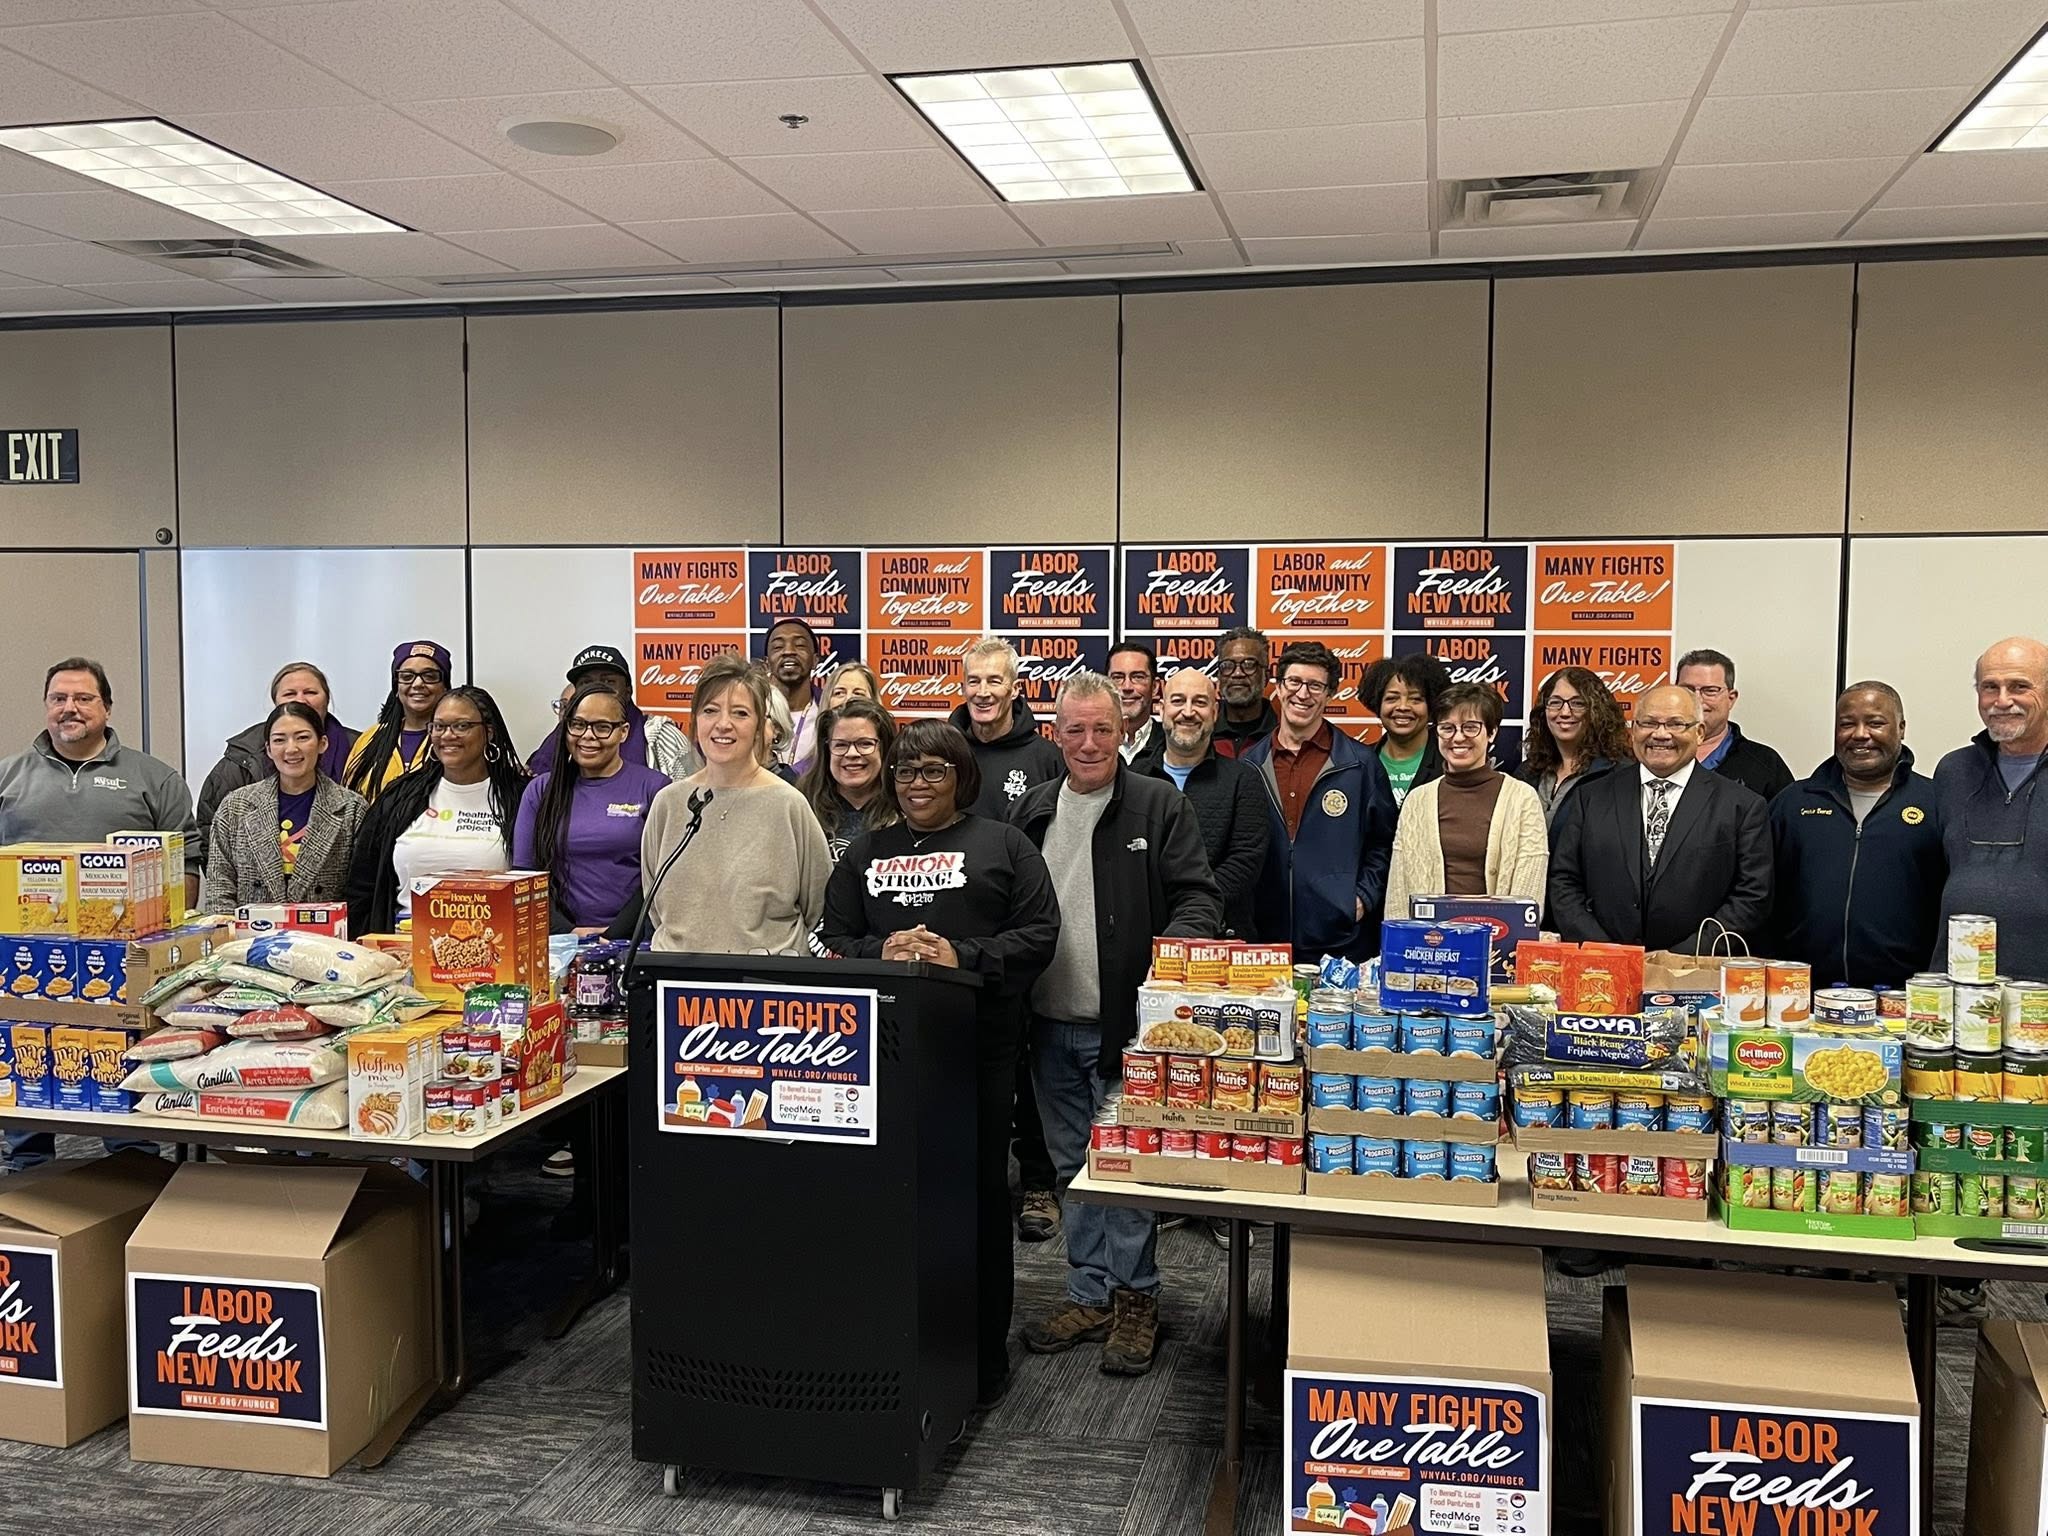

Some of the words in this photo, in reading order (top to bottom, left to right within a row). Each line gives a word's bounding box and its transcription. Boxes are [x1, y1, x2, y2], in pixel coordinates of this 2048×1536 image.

[8, 432, 62, 480] EXIT
[776, 554, 832, 573] LABOR
[882, 557, 929, 575] LABOR
[933, 556, 971, 574] and
[1021, 552, 1078, 573] LABOR
[1157, 551, 1217, 571] LABOR
[1273, 553, 1325, 571] LABOR
[1329, 551, 1372, 570] and
[1428, 550, 1493, 571] LABOR
[1544, 557, 1595, 576] MANY
[1601, 556, 1665, 576] FIGHTS
[641, 562, 682, 579] MANY
[687, 561, 738, 579] FIGHTS
[766, 569, 847, 598] Feeds
[880, 577, 970, 595] COMMUNITY
[1010, 568, 1094, 598] Feeds
[1146, 567, 1233, 597] Feeds
[1271, 573, 1372, 592] COMMUNITY
[1415, 565, 1510, 597] Feeds
[639, 583, 679, 606] One
[678, 582, 744, 605] Table!
[1540, 580, 1591, 605] One
[1590, 579, 1672, 604] Table!
[759, 593, 798, 614] NEW
[803, 594, 849, 615] YORK
[880, 591, 974, 627] Together
[1003, 593, 1045, 614] NEW
[1049, 593, 1097, 615] YORK
[1138, 592, 1180, 614] NEW
[1186, 592, 1236, 614] YORK
[1270, 588, 1375, 626] Together
[1407, 592, 1453, 614] NEW
[1457, 592, 1512, 614] YORK
[643, 644, 684, 661] MANY
[881, 639, 928, 655] LABOR
[932, 638, 971, 656] and
[1020, 638, 1079, 659] LABOR
[1156, 638, 1216, 660] LABOR
[1426, 638, 1490, 661] LABOR
[577, 650, 614, 666] YANKEES
[1543, 647, 1593, 667] MANY
[1599, 647, 1662, 667] FIGHTS
[640, 665, 682, 686] One
[880, 658, 965, 676] COMMUNIT
[455, 824, 492, 833] project
[23, 862, 61, 874] GOYA
[82, 855, 125, 868] GOYA
[875, 854, 957, 874] UNION
[873, 871, 953, 889] STRONG!
[451, 893, 473, 904] Honey
[473, 893, 487, 903] Nut
[429, 899, 492, 920] Cheerios
[1524, 906, 1537, 923] 6
[1232, 951, 1290, 966] HELPER
[1405, 949, 1434, 961] CHICKEN
[1434, 950, 1460, 963] BREAST
[453, 972, 493, 980] CHOLESTEROL
[469, 993, 498, 1007] Knorr
[678, 996, 754, 1029] MANY
[763, 999, 858, 1036] FIGHTS
[1222, 1004, 1253, 1017] GOYA
[1317, 1023, 1347, 1032] PROGRESSO
[1363, 1024, 1393, 1034] PROGRESSO
[1412, 1027, 1442, 1036] PROGRESSO
[1560, 1016, 1636, 1033] GOYA
[1453, 1030, 1483, 1039] PROGRESSO
[1573, 1036, 1598, 1046] Black
[1599, 1038, 1626, 1049] Beans
[679, 1022, 760, 1061] One
[757, 1026, 858, 1067] Table
[1566, 1045, 1599, 1057] Frijoles
[1600, 1049, 1631, 1060] Negros
[1884, 1046, 1898, 1058] 12
[1740, 1049, 1753, 1058] Del
[1754, 1050, 1783, 1060] Monte
[352, 1052, 405, 1079] Stuffing
[679, 1063, 694, 1072] Food
[694, 1064, 711, 1073] Drive
[197, 1070, 235, 1090] Canilla
[771, 1068, 858, 1082] WNYALF.ORG/HUNGER
[1126, 1068, 1157, 1081] Hunt's
[1170, 1069, 1201, 1084] Hunt's
[1216, 1074, 1248, 1086] Hunt's
[1529, 1073, 1552, 1081] GOYA
[1267, 1078, 1299, 1092] Hunt's
[1322, 1083, 1350, 1093] PROGRESSO
[1365, 1086, 1394, 1095] PROGRESSO
[1729, 1080, 1749, 1088] WHOLE
[1749, 1081, 1773, 1089] KERNEL
[155, 1092, 194, 1112] Canilla
[1411, 1089, 1442, 1098] PROGRESSO
[1455, 1091, 1483, 1100] PROGRESSO
[205, 1104, 244, 1115] Enriched
[245, 1106, 266, 1117] Rice
[1519, 1100, 1549, 1109] PROGRESSO
[1669, 1104, 1700, 1113] PROGRESSO
[1364, 1148, 1393, 1158] PROGRESSO
[1416, 1151, 1444, 1160] PROGRESSO
[1454, 1153, 1483, 1163] PROGRESSO
[1540, 1152, 1561, 1162] Dinty
[1538, 1159, 1562, 1168] Moore
[1631, 1164, 1656, 1174] Moore
[1633, 1157, 1654, 1168] Dinty
[183, 1286, 273, 1325] LABOR
[167, 1315, 298, 1362] Feeds
[157, 1350, 220, 1387] NEW
[228, 1356, 303, 1394] YORK
[185, 1395, 276, 1410] WNYALF.ORG/HUNGER
[1309, 1388, 1399, 1426] MANY
[1410, 1393, 1524, 1435] FIGHTS
[1309, 1417, 1406, 1462] One
[1402, 1423, 1524, 1469] Table
[1710, 1415, 1838, 1465] LABOR
[1309, 1463, 1327, 1474] Food
[1328, 1465, 1347, 1475] Drive
[1367, 1467, 1406, 1478] Fundraiser
[1420, 1469, 1524, 1487] WNYALF.ORG/HUNGER
[1685, 1451, 1874, 1511] Feeds
[1429, 1488, 1437, 1497] To
[1439, 1489, 1463, 1499] Benefit
[1464, 1491, 1482, 1500] Local
[1429, 1498, 1446, 1507] Food
[1447, 1499, 1473, 1509] Pantries
[1671, 1493, 1760, 1536] NEW
[1772, 1502, 1880, 1536] YORK
[1430, 1519, 1452, 1529] wny
